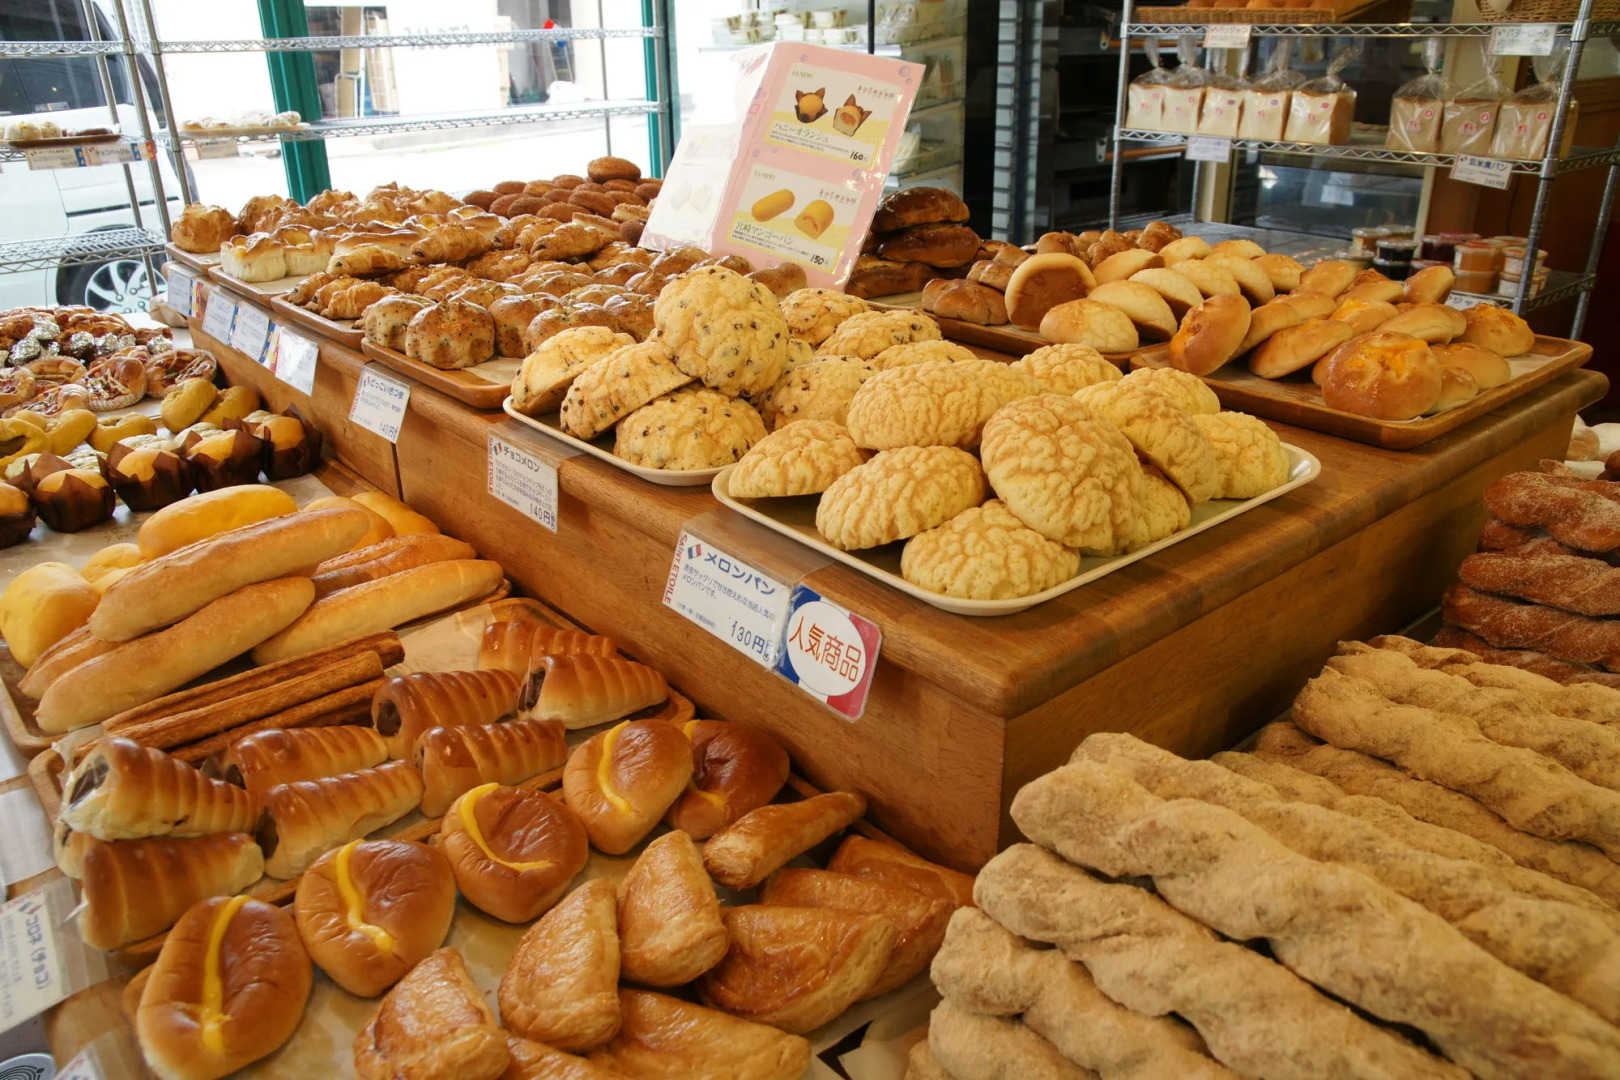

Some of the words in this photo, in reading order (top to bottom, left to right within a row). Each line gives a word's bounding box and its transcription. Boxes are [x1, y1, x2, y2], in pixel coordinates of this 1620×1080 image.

[503, 446, 540, 472] チョコメロン
[530, 503, 551, 525] 140円
[674, 534, 688, 565] SAINT
[664, 564, 680, 605] ETOILE
[704, 552, 775, 595] メロンパン
[731, 620, 766, 654] 130円
[788, 616, 862, 683] 人気商品
